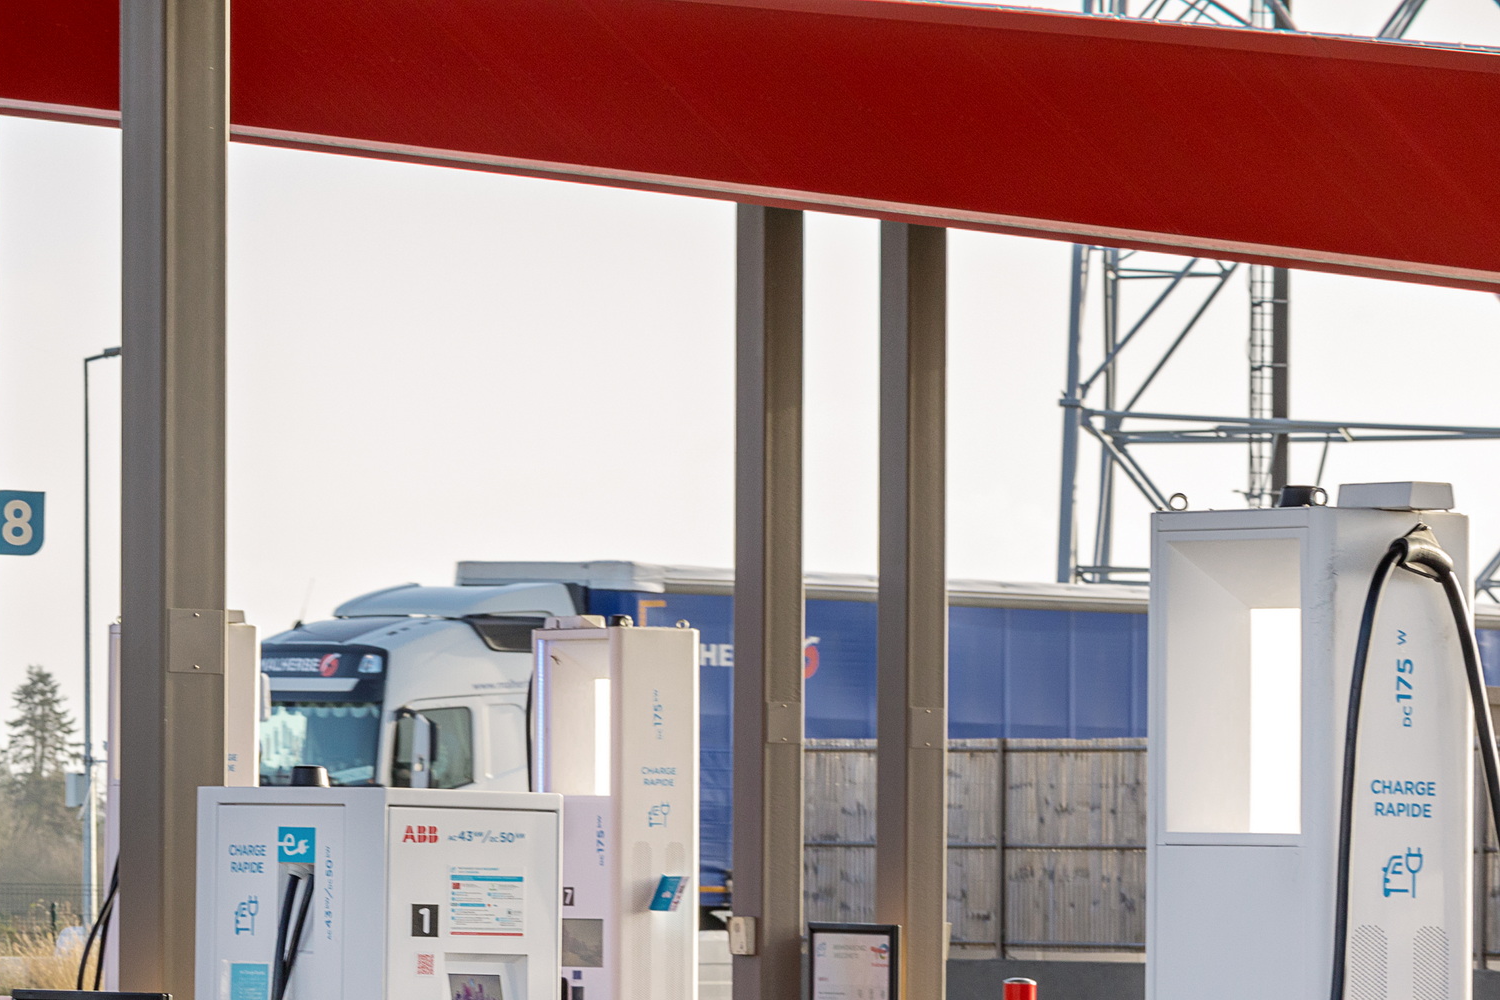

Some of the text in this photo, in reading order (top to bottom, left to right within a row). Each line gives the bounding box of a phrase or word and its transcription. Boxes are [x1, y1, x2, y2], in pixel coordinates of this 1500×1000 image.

[1, 499, 33, 546] 8
[1396, 658, 1414, 703] 175
[1403, 705, 1413, 728] DC
[641, 767, 677, 776] CHARGE
[643, 778, 675, 787] RAPIDE
[1370, 779, 1437, 796] CHARGE
[1374, 801, 1433, 818] RAPIDE
[402, 825, 439, 843] ABB
[228, 844, 267, 857] CHARGE
[230, 861, 265, 873] RAPIDE
[564, 889, 573, 903] 7
[418, 907, 431, 934] 1
